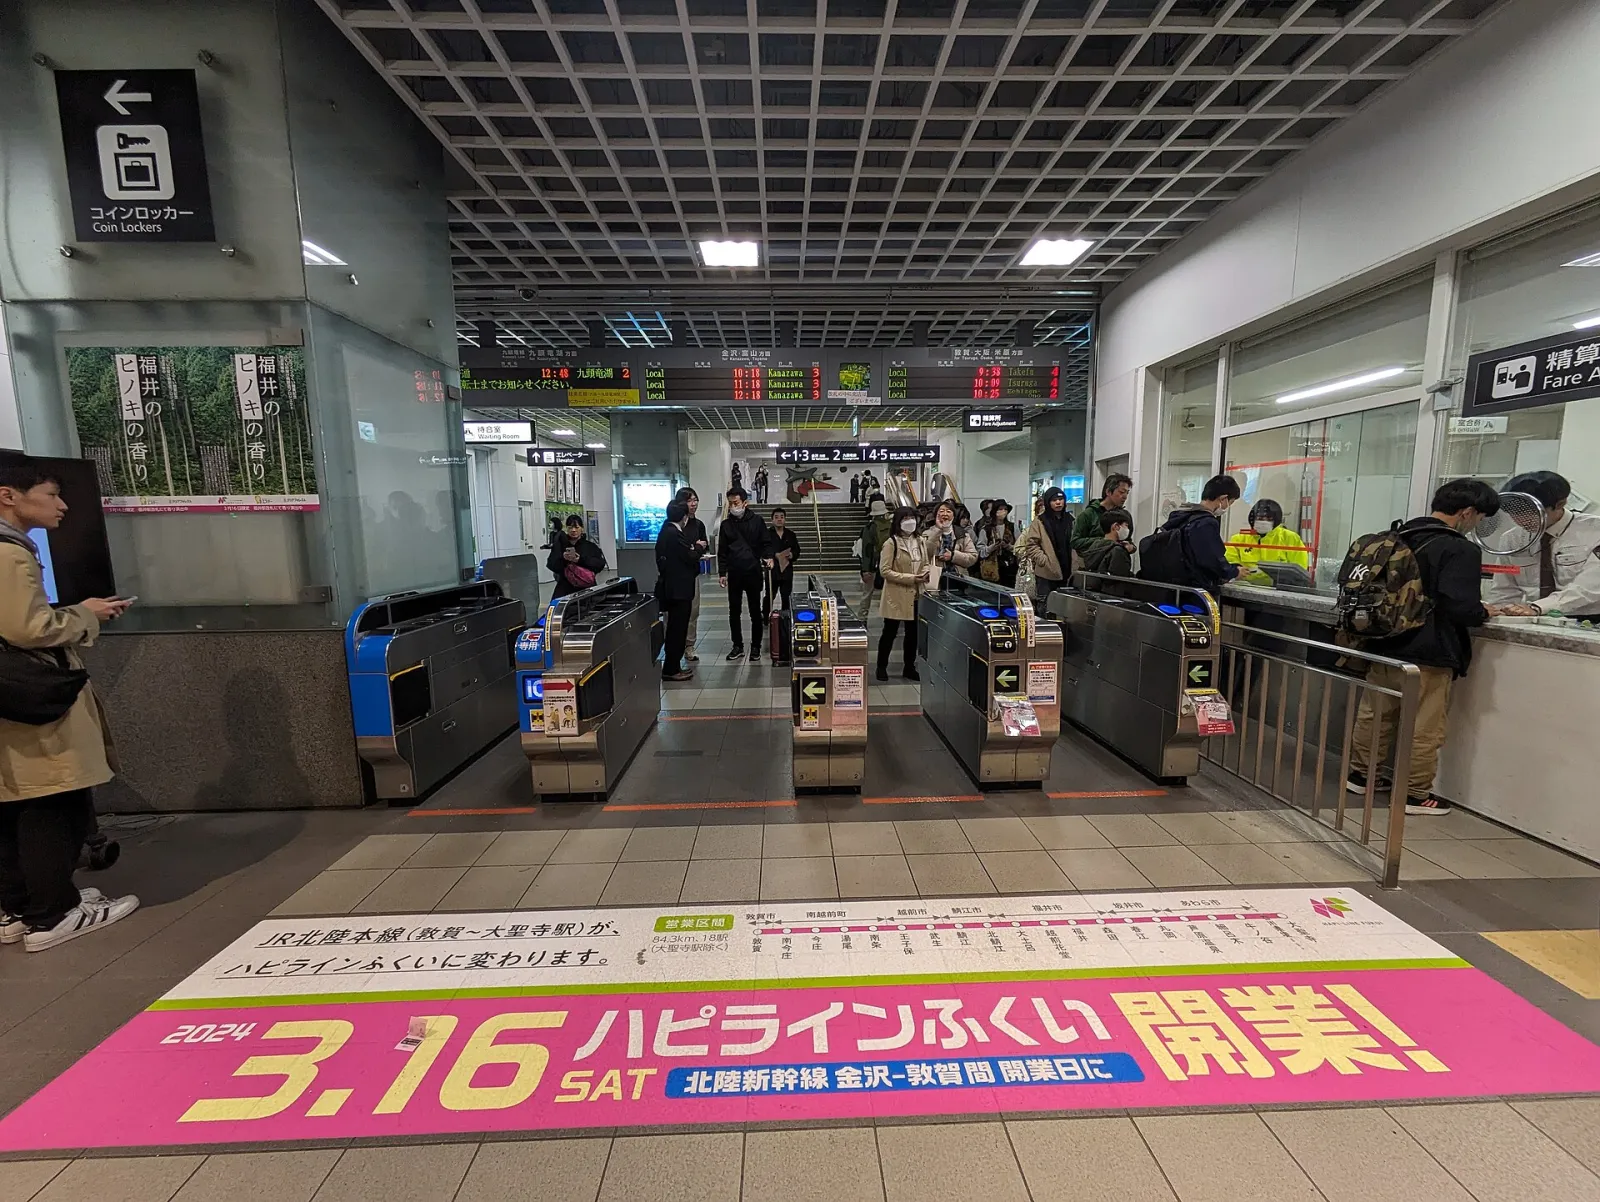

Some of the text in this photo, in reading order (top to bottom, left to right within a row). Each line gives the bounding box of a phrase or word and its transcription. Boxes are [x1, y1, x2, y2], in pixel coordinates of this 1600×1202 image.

[90, 206, 194, 221] コインロッカー
[92, 222, 162, 233] Coin Lockers
[460, 369, 470, 378] 通
[542, 368, 569, 378] 12:48
[576, 368, 613, 378] 九頭竜湖
[622, 369, 630, 378] 2
[646, 369, 664, 378] Local
[733, 368, 760, 378] 10:18
[768, 368, 803, 377] Kanazawa
[812, 368, 820, 377] 3
[888, 368, 907, 377] Local
[978, 367, 1000, 376] 9:38
[1008, 367, 1034, 376] Takefu
[1051, 367, 1058, 376] 4
[646, 380, 665, 389] Local
[733, 380, 760, 389] 11:18
[768, 379, 803, 388] Kanazawa
[812, 380, 820, 388] 3
[888, 379, 907, 387] Local
[974, 378, 1000, 387] 10:09
[1008, 379, 1038, 387] Tsuruga
[1051, 378, 1058, 387] 4
[1542, 371, 1582, 390] Fare
[138, 356, 162, 416] 福井の
[257, 356, 280, 416] 福井の
[647, 391, 665, 400] Local
[734, 391, 760, 400] 12:18
[768, 390, 803, 399] Kanazawa
[812, 391, 820, 399] 3
[888, 390, 907, 398] Local
[974, 389, 1000, 398] 10:25
[1050, 389, 1058, 398] 2
[120, 356, 148, 481] ヒノキの香り
[239, 356, 266, 480] ヒノキの香り
[833, 450, 840, 460] 2
[665, 919, 726, 929] 営業区間
[956, 932, 972, 946] 鯖江
[1072, 928, 1088, 942] 福井
[1102, 927, 1119, 941] 森田
[811, 936, 823, 950] 今庄
[841, 935, 853, 950] 湯尾
[869, 935, 882, 949] 南条
[900, 933, 915, 956] 王子保
[930, 932, 943, 947] 武生
[988, 931, 1006, 953] 北鯖江
[1045, 930, 1072, 959] 越前花堂
[651, 943, 729, 954] (大聖寺駅除く)
[752, 938, 763, 953] 敦賀
[781, 938, 793, 960] 南今庄
[224, 950, 609, 976] ハピラインふくいに変わります。
[159, 1022, 258, 1044] 2024
[573, 996, 1114, 1061] ハピラインふくい
[1110, 984, 1452, 1081] 開業!
[177, 1011, 569, 1122] 3.16
[684, 1066, 829, 1095] 北陸新幹線
[1000, 1056, 1114, 1083] 開業日に
[553, 1068, 658, 1103] SAT
